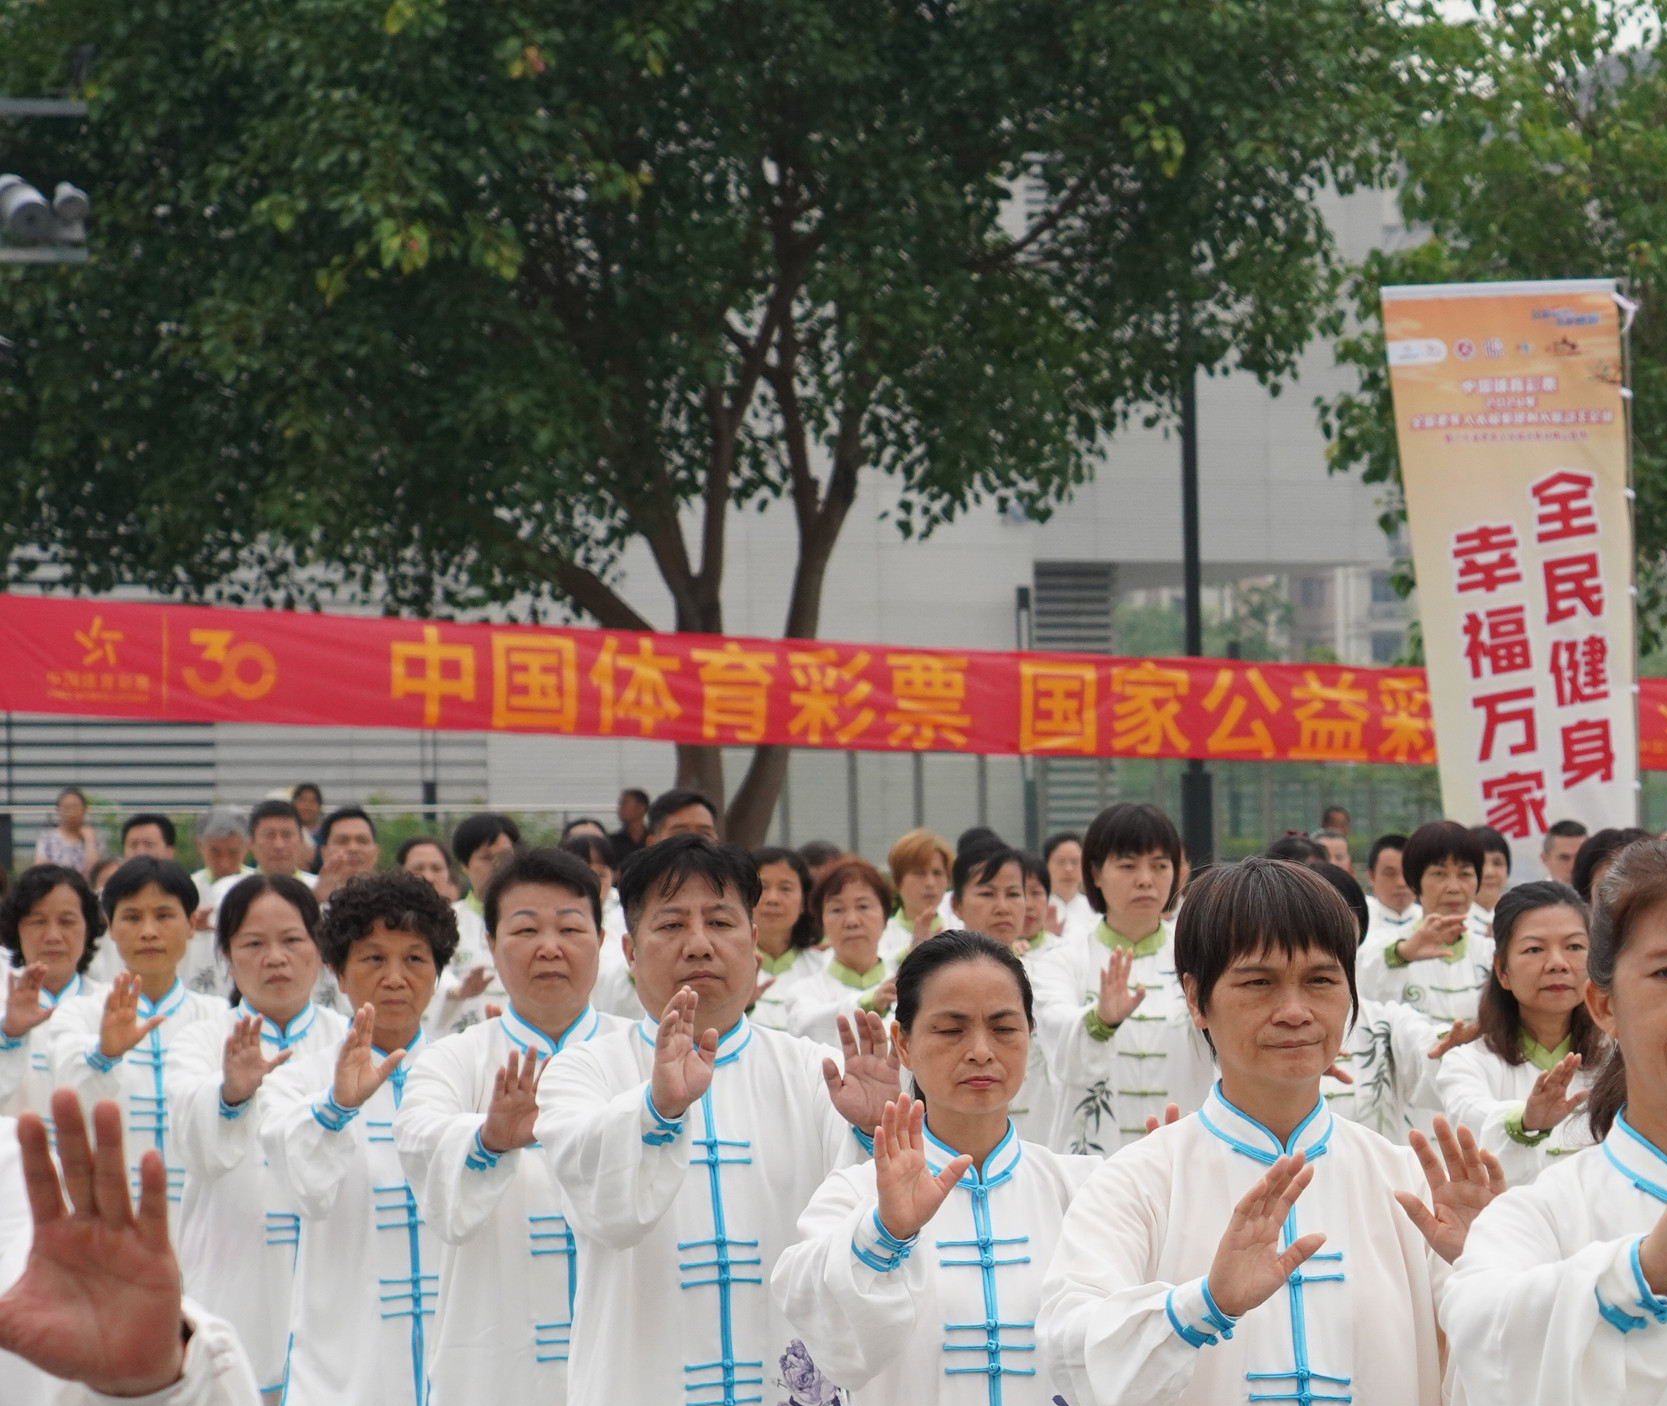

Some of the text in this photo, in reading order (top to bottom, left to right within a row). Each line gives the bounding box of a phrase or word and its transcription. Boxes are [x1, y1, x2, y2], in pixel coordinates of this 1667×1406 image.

[181, 628, 278, 700] 30
[391, 625, 971, 748] 中国体育彩票
[1452, 525, 1549, 839] 幸福万家
[1531, 472, 1616, 789] 全民健身
